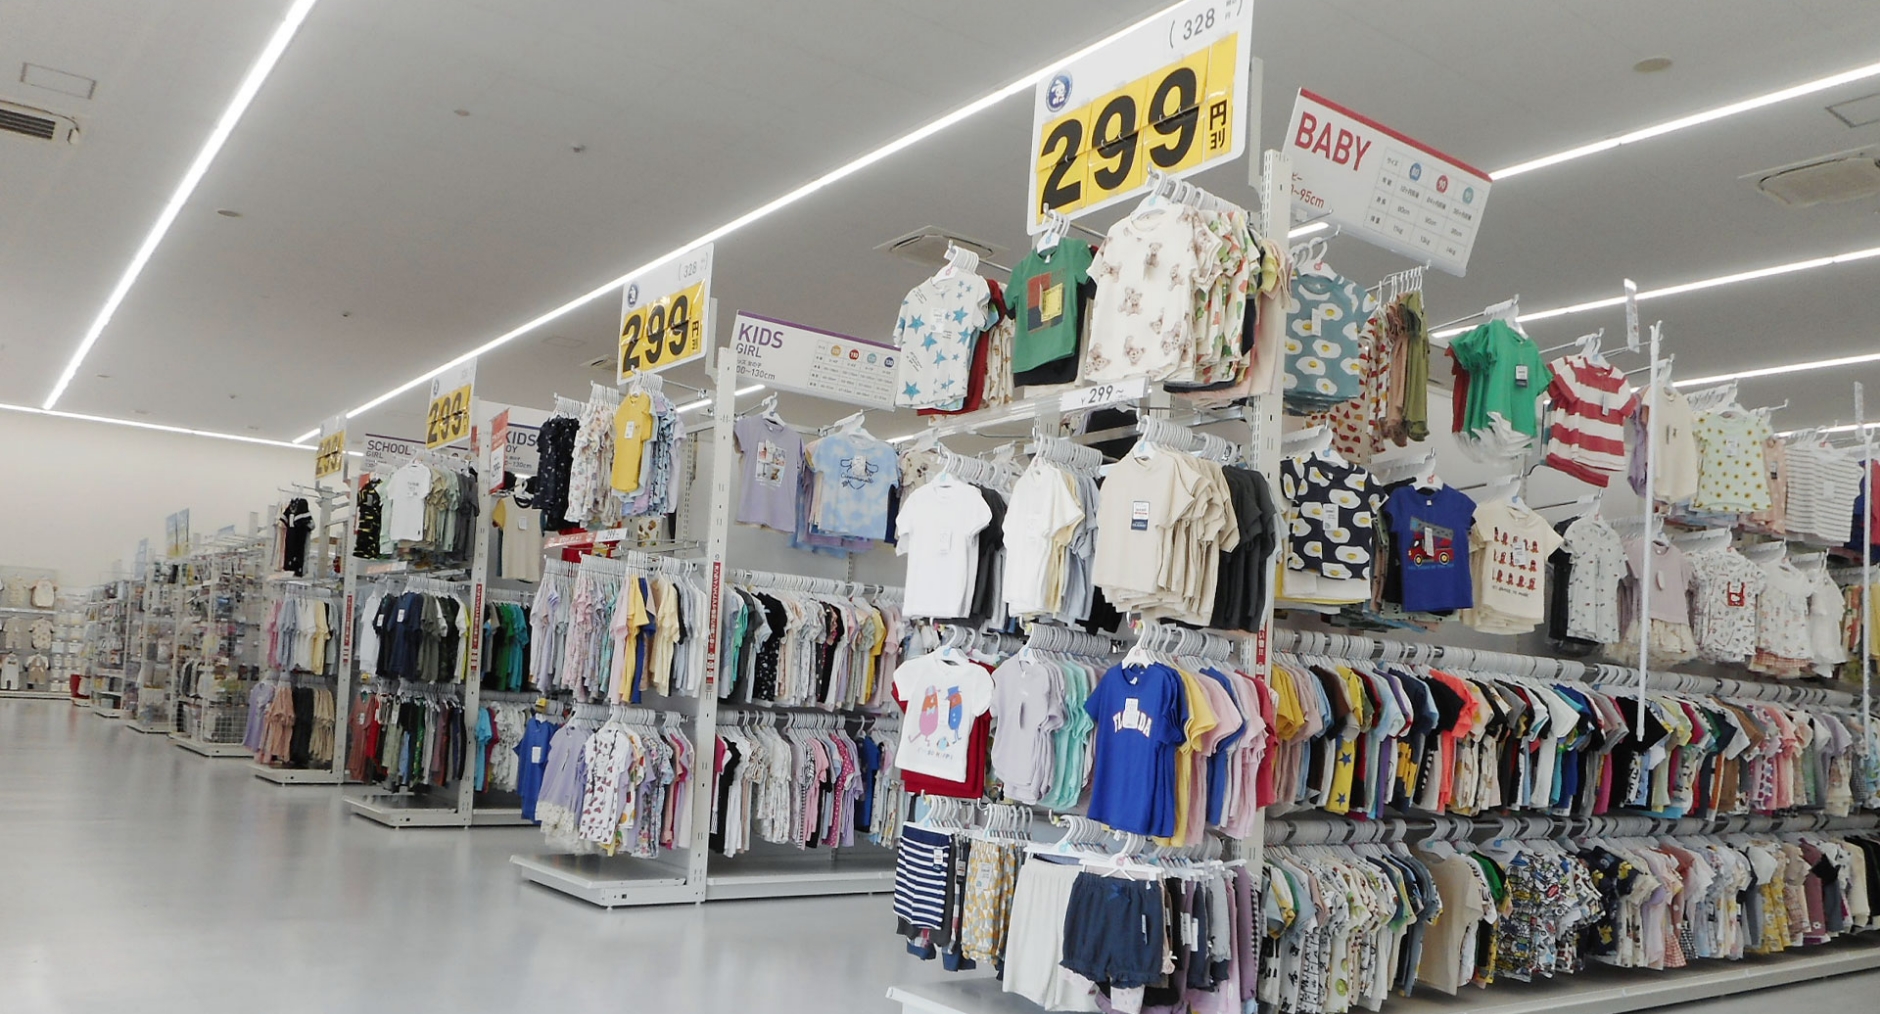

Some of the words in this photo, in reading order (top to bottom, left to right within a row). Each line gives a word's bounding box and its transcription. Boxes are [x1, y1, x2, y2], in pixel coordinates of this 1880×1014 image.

[1041, 66, 1200, 214] 299
[1294, 111, 1372, 171] BABY
[622, 295, 689, 373] 299
[738, 323, 784, 349] KIDS
[736, 342, 762, 358] GIRL
[1088, 384, 1114, 404] 299
[427, 391, 462, 444] 299
[366, 450, 384, 459] GIRL
[367, 439, 412, 456] SCHOOL
[1112, 711, 1152, 738] FLDA
